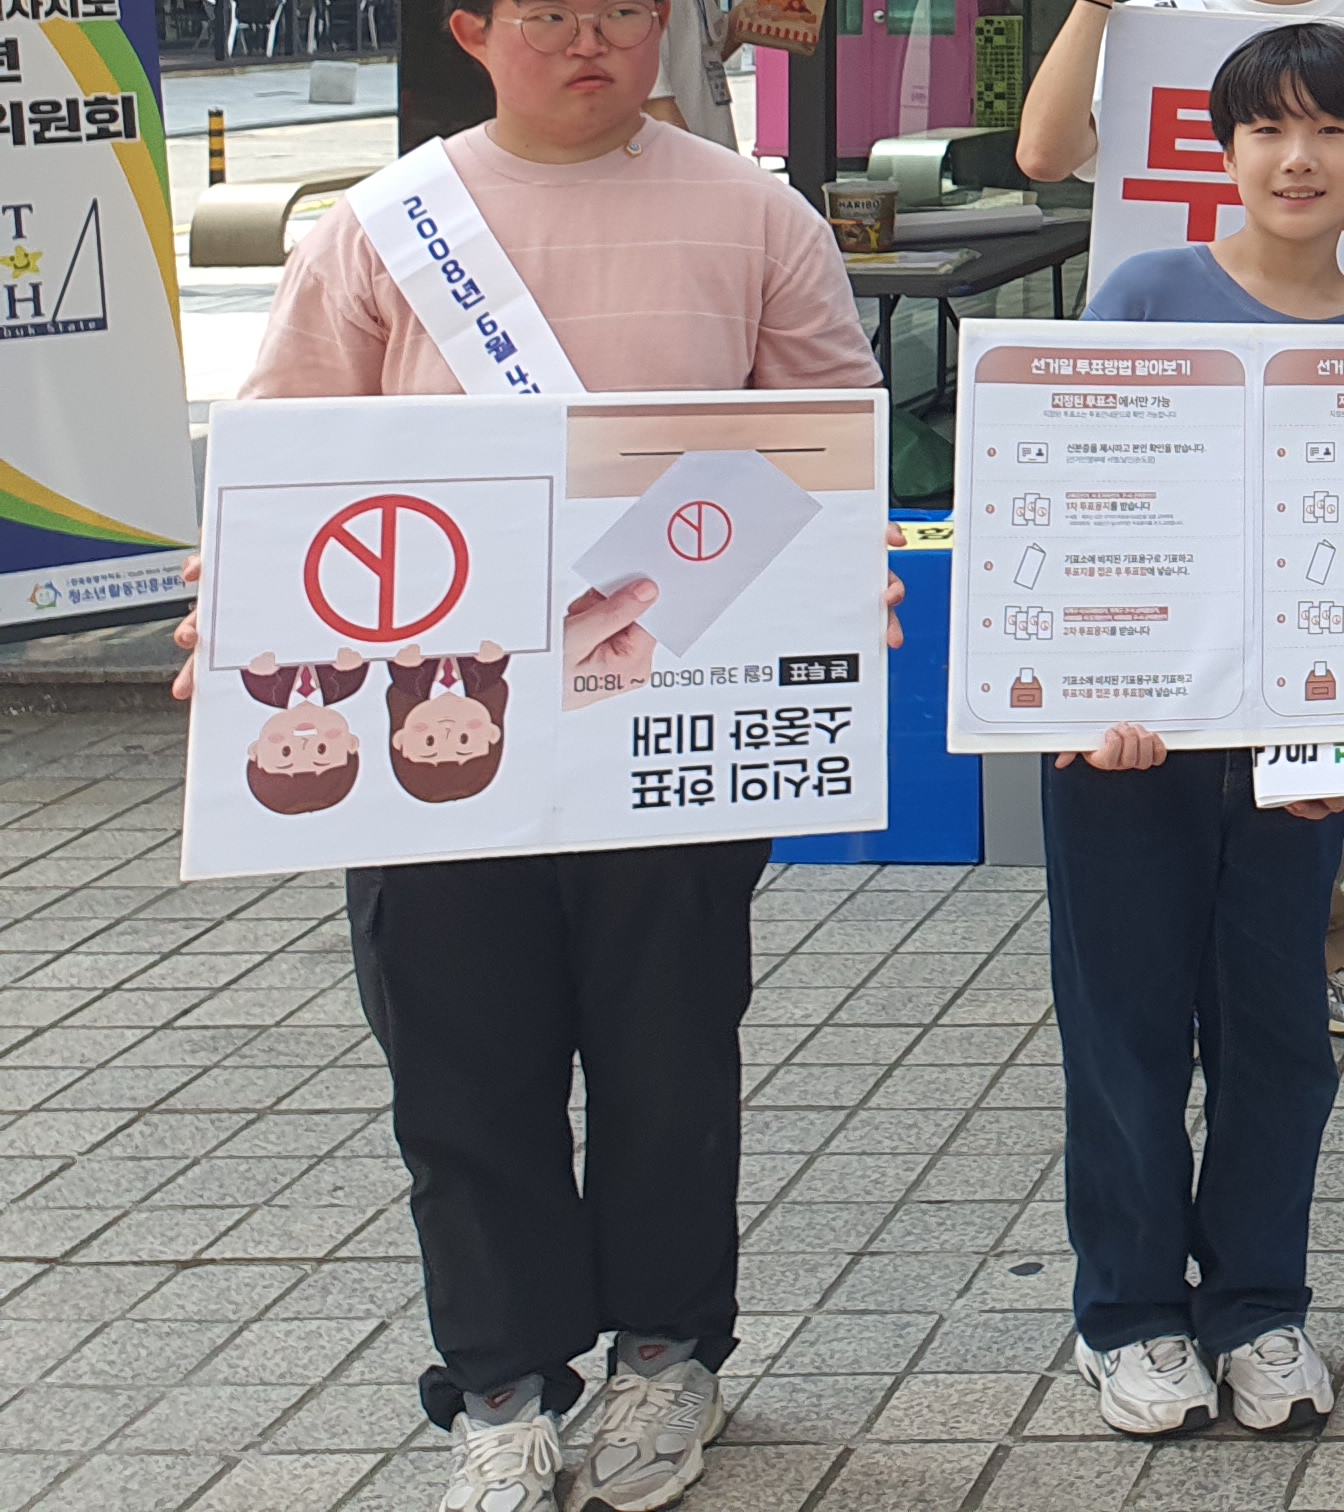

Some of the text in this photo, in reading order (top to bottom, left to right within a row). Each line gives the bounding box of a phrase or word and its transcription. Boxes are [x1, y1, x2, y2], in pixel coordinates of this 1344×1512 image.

[838, 198, 881, 210] HARIBO
[402, 195, 485, 310] 2008년
[476, 311, 518, 364] 6월
[1031, 358, 1191, 376] 선거일 투표방법 알아보기
[573, 673, 624, 693] 18:00
[651, 668, 704, 688] 06:00
[710, 666, 739, 685] 3일
[744, 664, 774, 684] 6월
[632, 706, 853, 758] 소중한 미래
[630, 755, 853, 810] 당신의 한표
